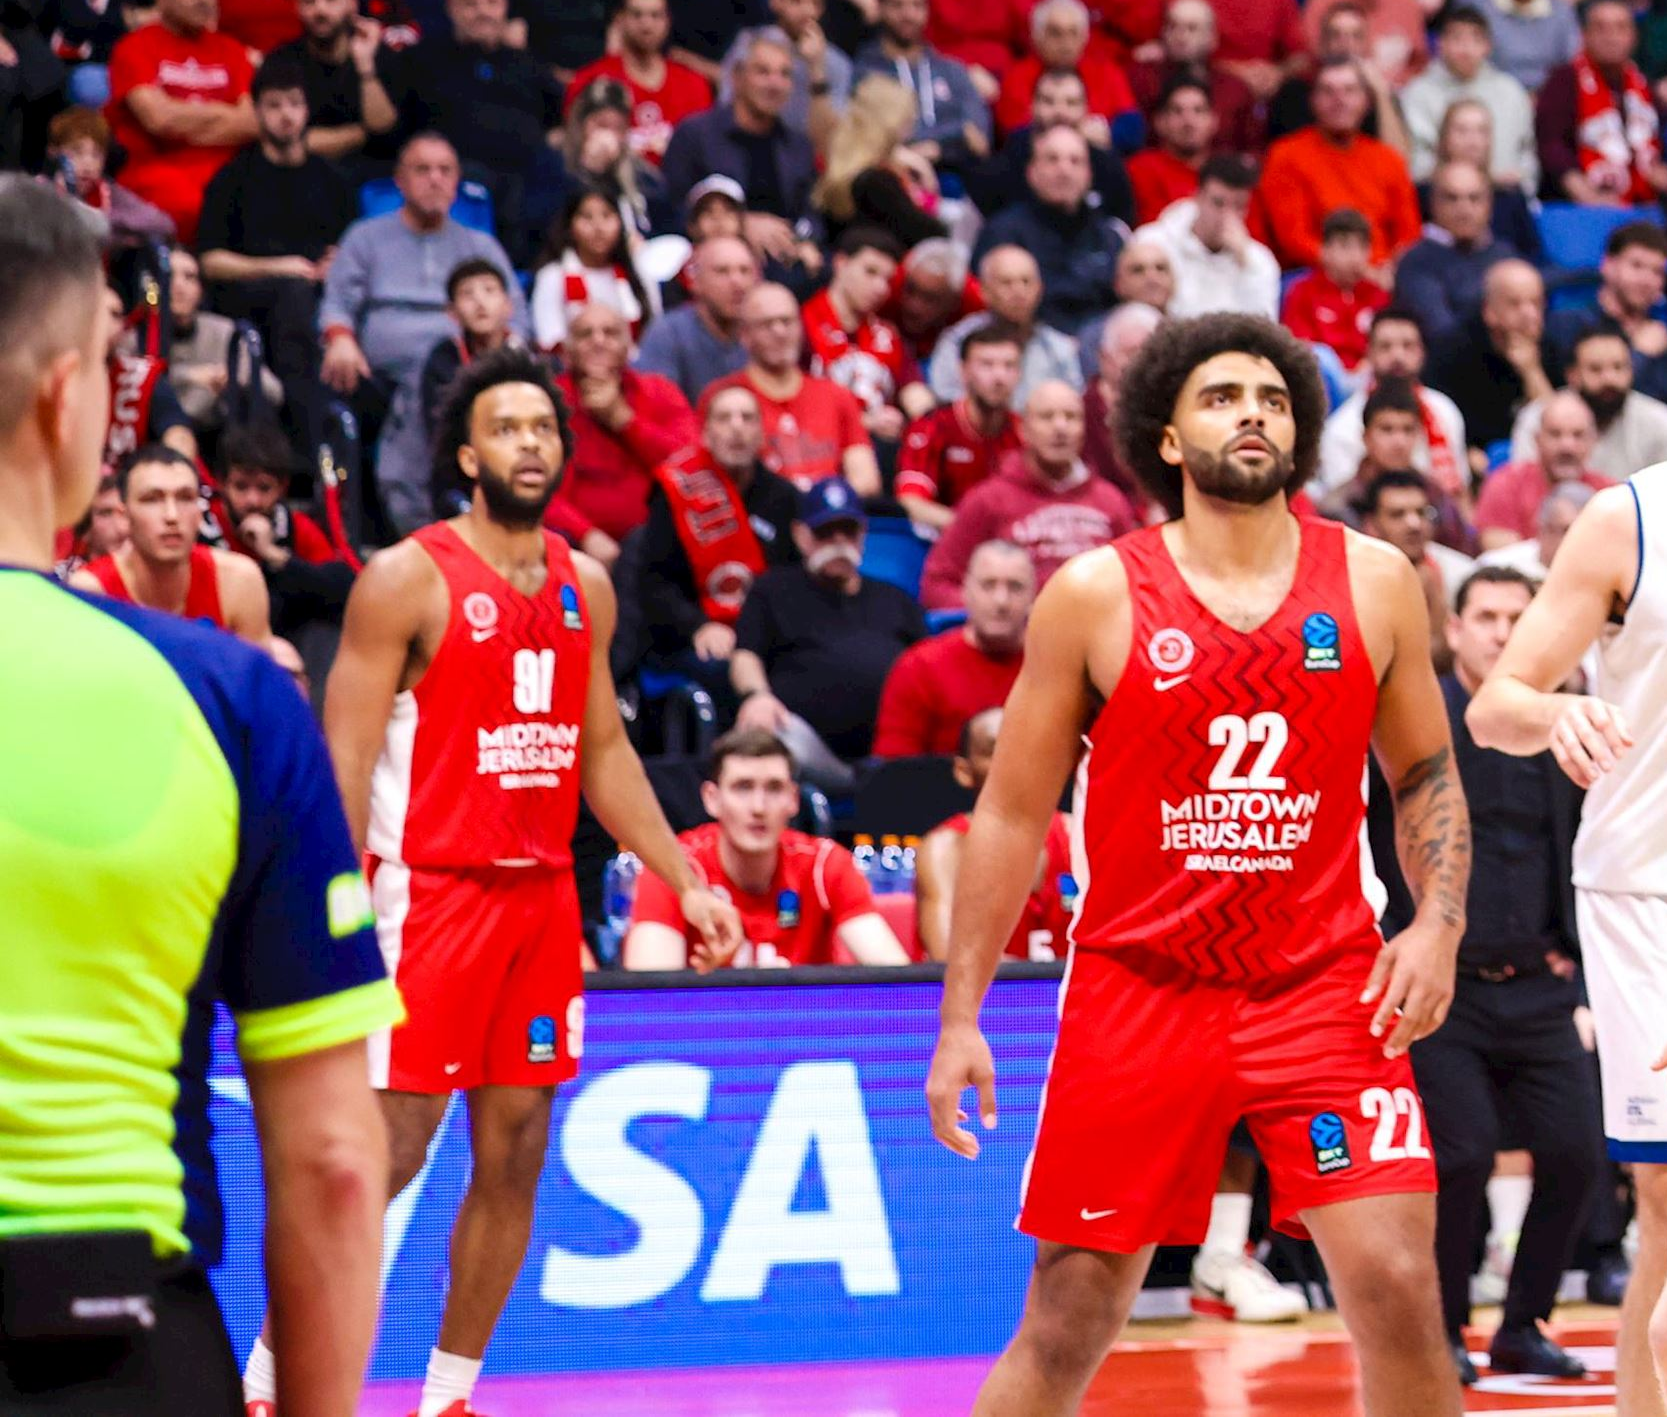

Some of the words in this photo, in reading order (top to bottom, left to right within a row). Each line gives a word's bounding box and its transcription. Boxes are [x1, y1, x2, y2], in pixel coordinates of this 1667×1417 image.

[512, 647, 556, 715] 91
[1207, 710, 1289, 791] 22
[1160, 790, 1321, 825] MIDTOWN
[1160, 818, 1314, 852] JERUSALEM
[1359, 1086, 1431, 1163] 22
